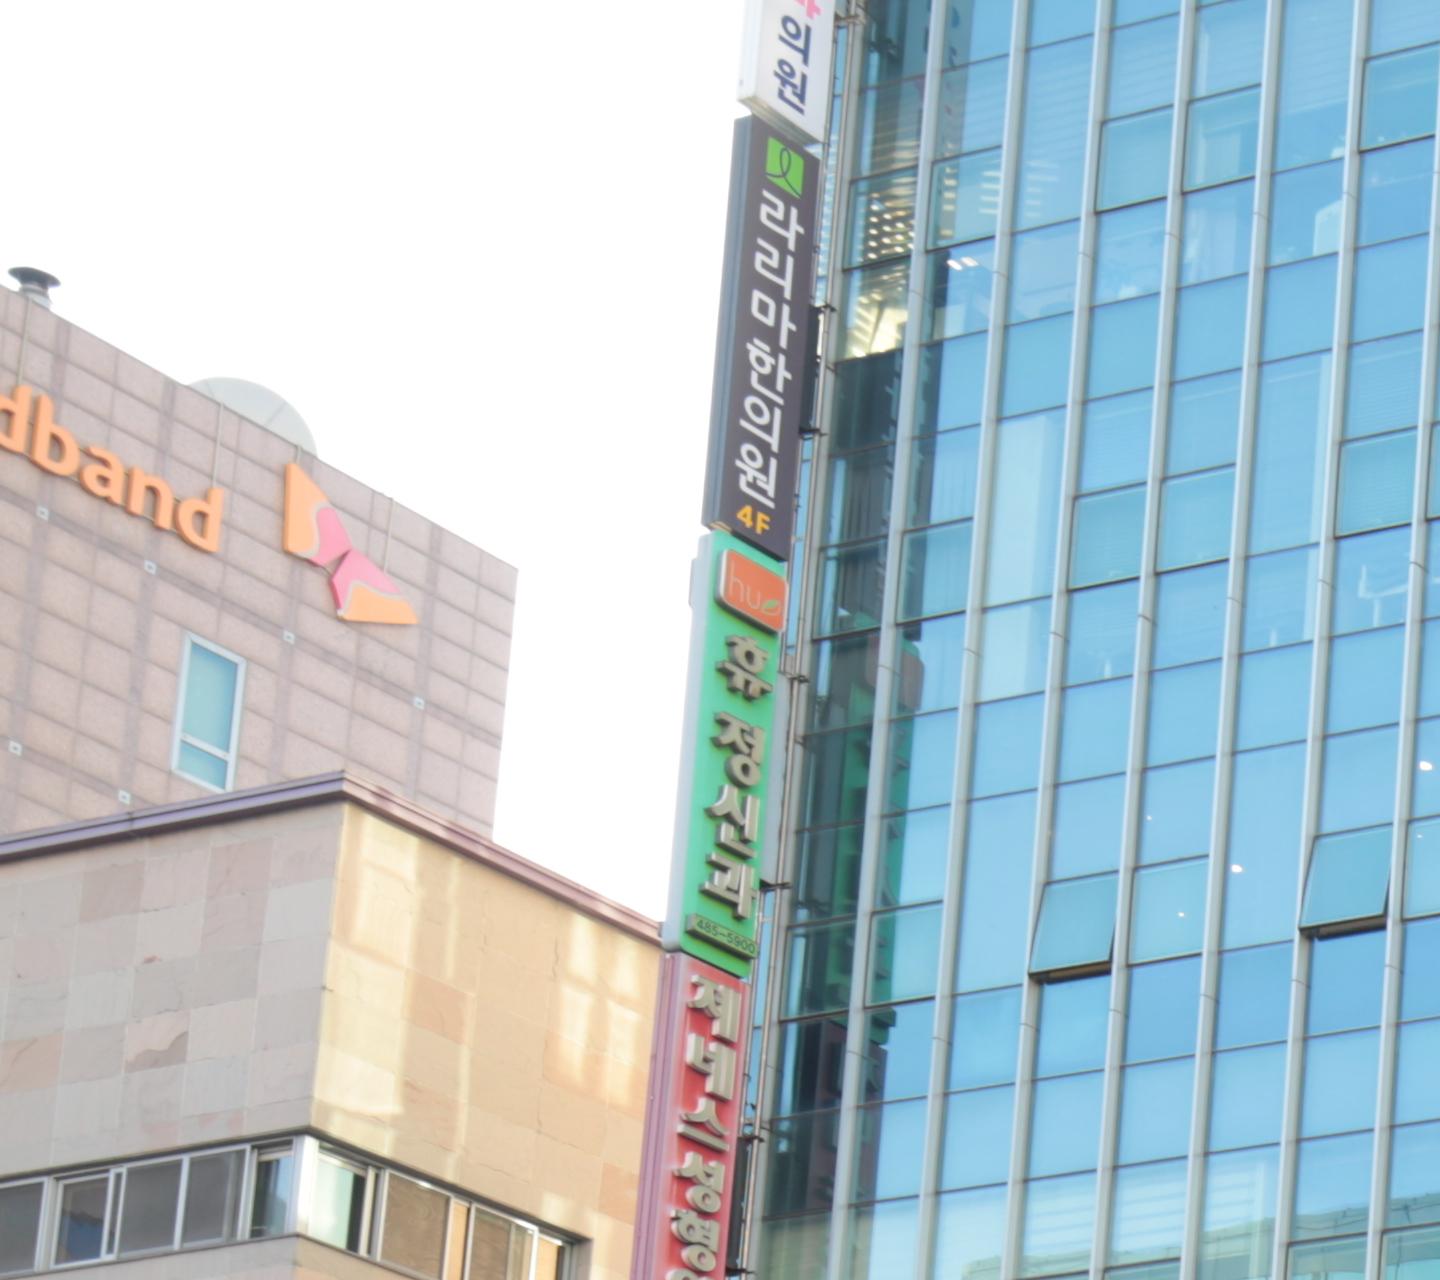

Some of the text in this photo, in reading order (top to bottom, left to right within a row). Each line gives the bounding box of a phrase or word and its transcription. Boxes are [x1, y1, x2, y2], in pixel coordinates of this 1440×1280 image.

[735, 190, 806, 534] 라리마한의원 4F
[699, 633, 772, 920] 휴 정신과
[694, 915, 757, 955] 485-5900
